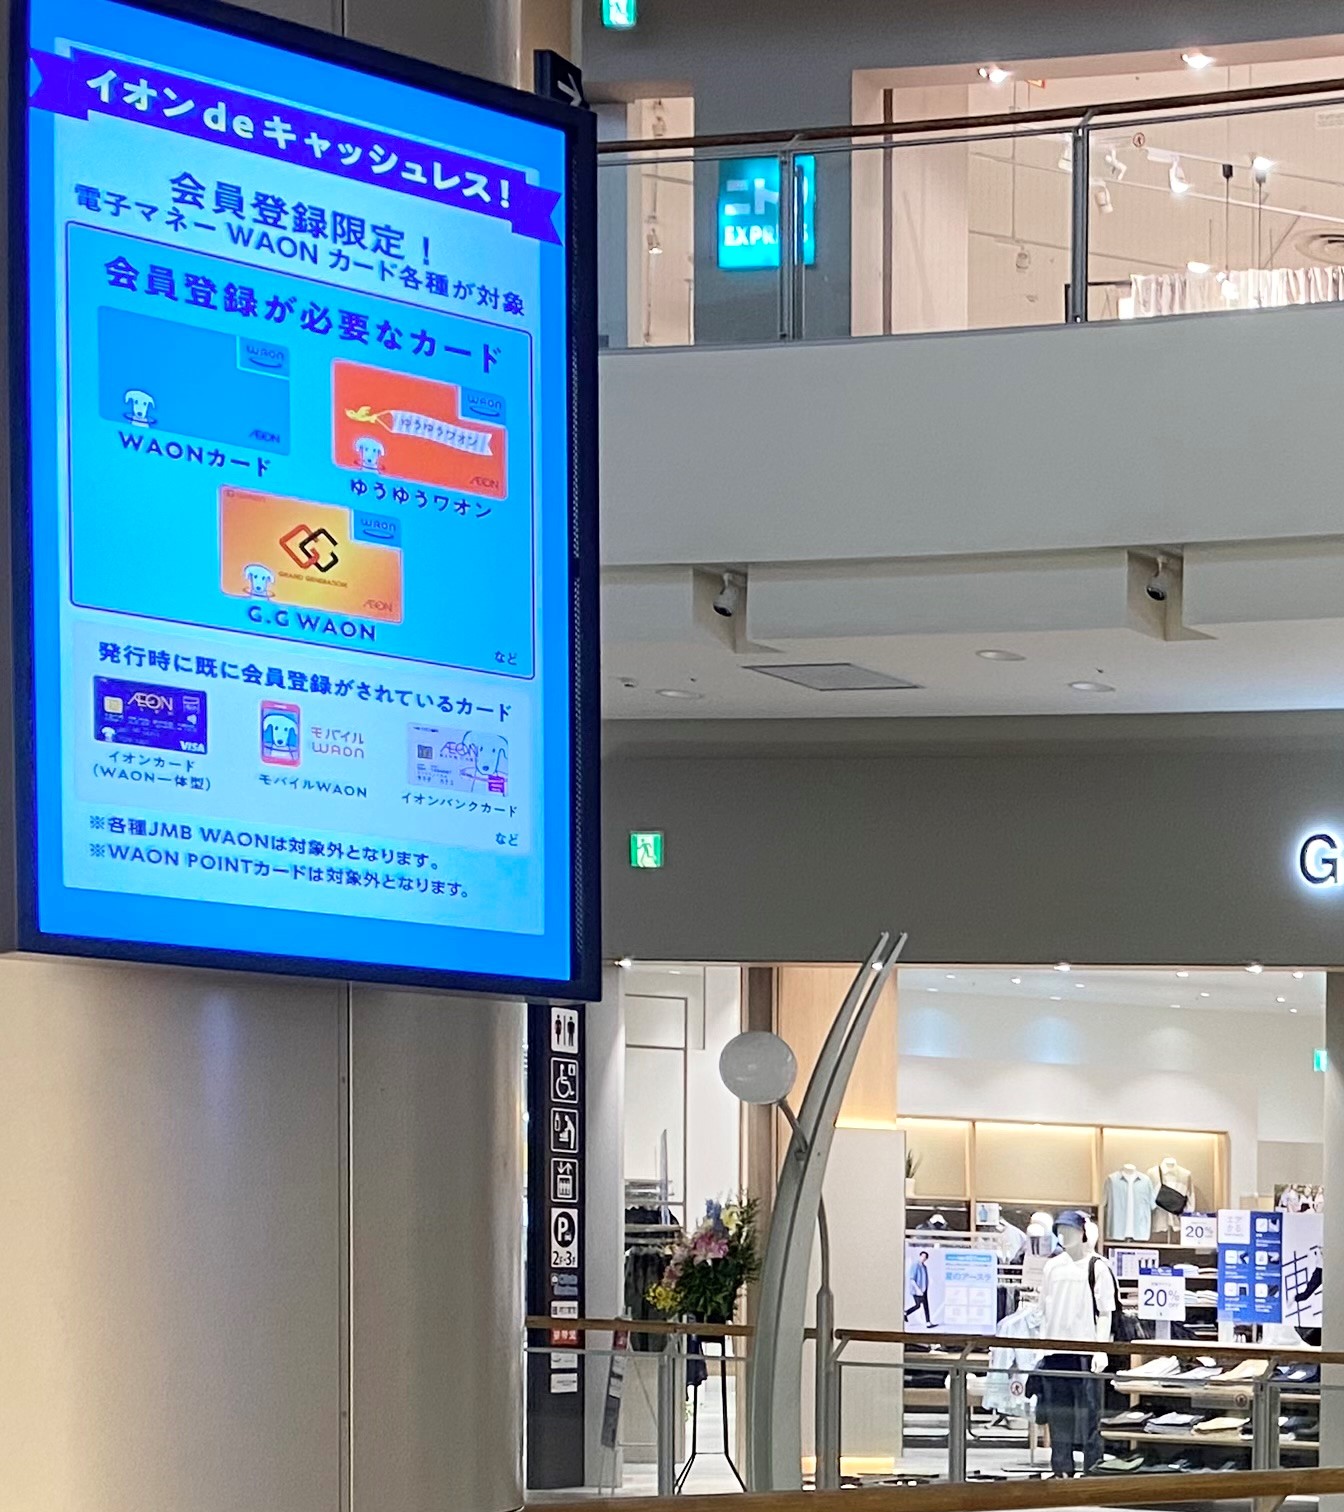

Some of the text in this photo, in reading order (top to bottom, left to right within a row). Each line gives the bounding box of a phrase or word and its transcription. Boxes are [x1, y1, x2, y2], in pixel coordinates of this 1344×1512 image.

[227, 221, 319, 265] WAON
[724, 224, 809, 247] EXPR
[104, 255, 501, 374] 会員登録が必要なカード
[118, 430, 272, 478] WAONカード
[350, 478, 492, 519] ゆうゆうワオン
[296, 613, 377, 642] WAON
[494, 650, 518, 666] など
[98, 641, 511, 722] 発行時に既に会員登録がされているカード
[179, 739, 205, 753] VISA
[108, 750, 195, 773] イオンカード
[259, 773, 368, 798] モバイルWAON
[401, 792, 518, 818] イオンバンクカード
[495, 832, 519, 847] など
